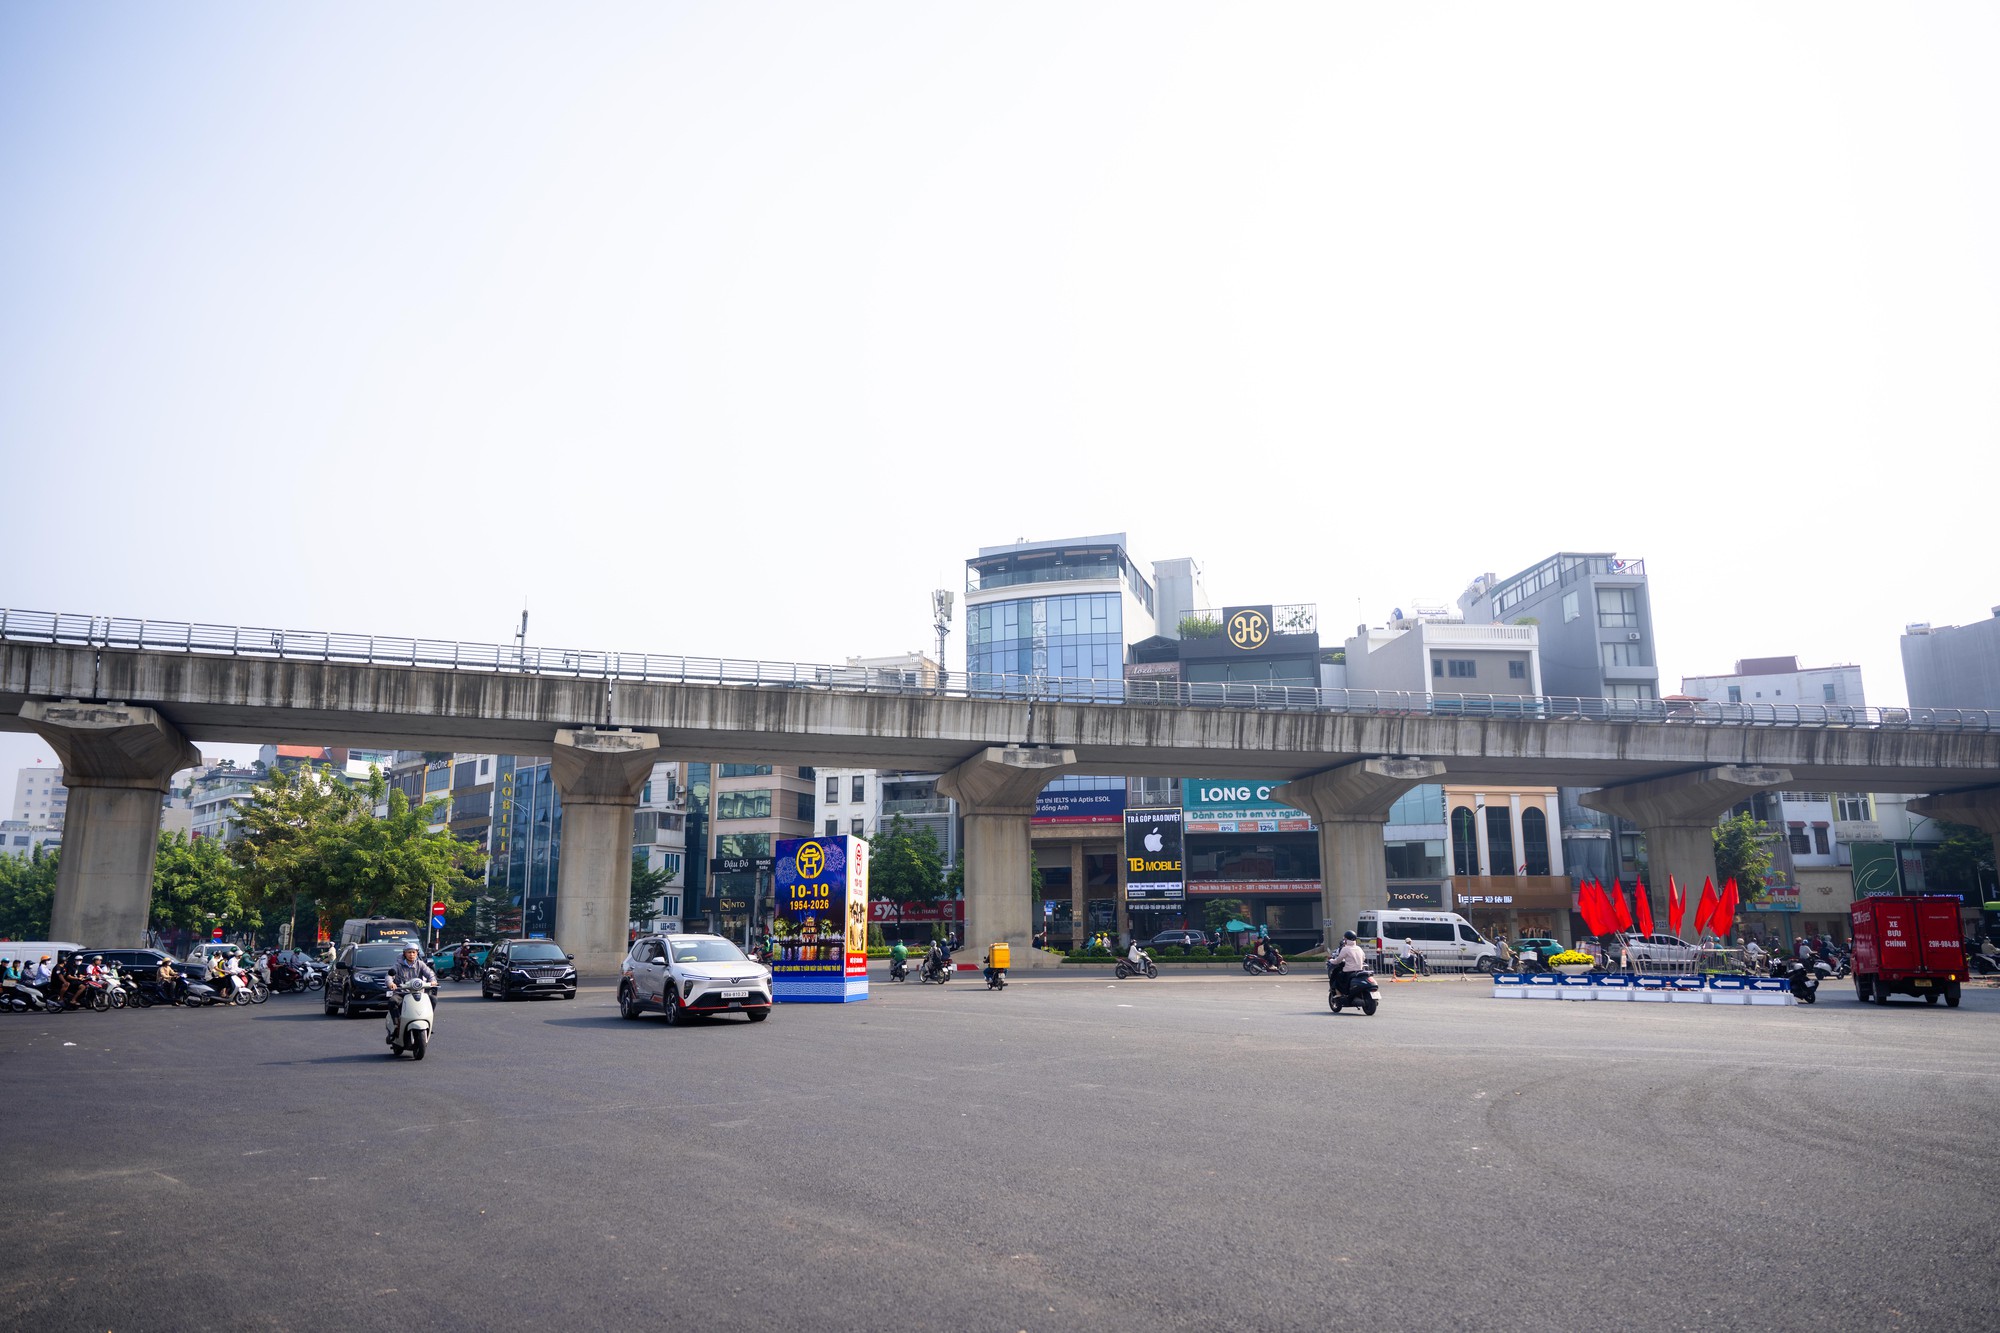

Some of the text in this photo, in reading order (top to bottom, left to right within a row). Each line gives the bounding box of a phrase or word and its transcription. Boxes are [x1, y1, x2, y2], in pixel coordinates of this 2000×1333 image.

[1200, 787, 1251, 802] LONG
[1140, 813, 1152, 823] GÓP
[1152, 814, 1164, 823] BAO
[1192, 810, 1215, 819] Dành
[1217, 809, 1234, 819] cho
[1127, 857, 1182, 872] TB MOBILE
[790, 883, 829, 899] 10-10
[790, 899, 829, 910] 1954-2026
[1885, 938, 1907, 948] CHÍNH
